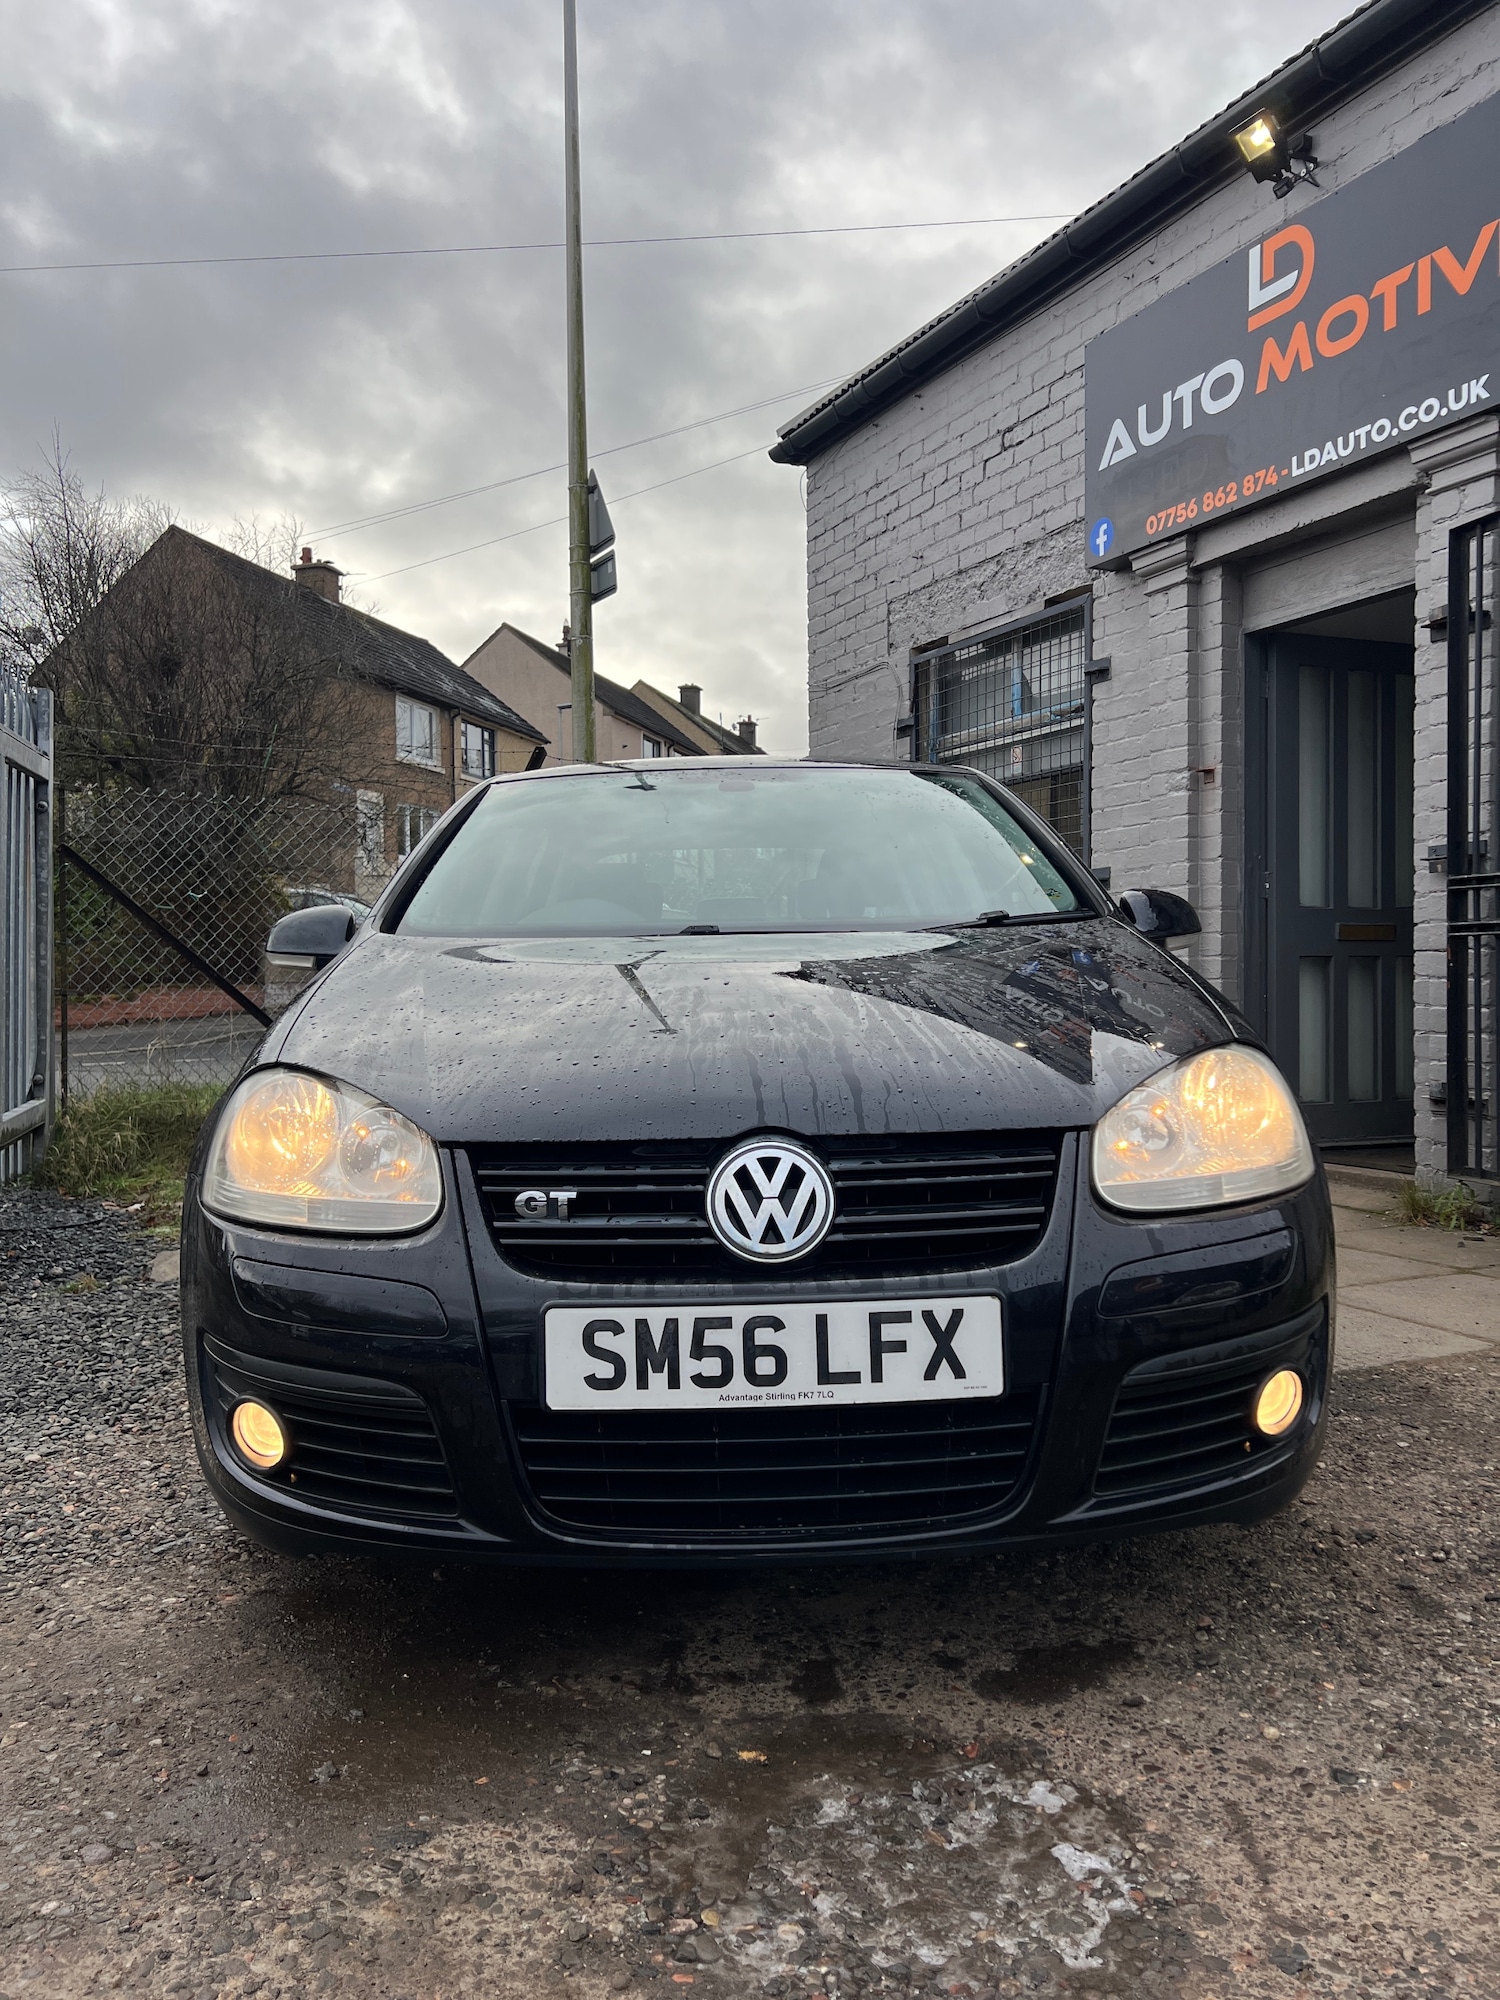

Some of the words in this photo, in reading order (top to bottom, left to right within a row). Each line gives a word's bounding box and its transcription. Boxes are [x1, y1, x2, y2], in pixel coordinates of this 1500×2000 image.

[1247, 223, 1316, 333] LD
[1098, 358, 1245, 472] AUTO
[1254, 217, 1500, 395] MOTIV
[1145, 497, 1198, 535] 07756
[1202, 481, 1238, 513] 862
[1241, 464, 1279, 497] 874
[1290, 372, 1491, 478] LDAUTO.CO.UK
[514, 1190, 578, 1224] GT
[581, 1315, 788, 1391] SM56
[815, 1308, 967, 1386] LFX
[718, 1393, 763, 1402] Advantage
[765, 1392, 796, 1401] Stirling
[798, 1391, 815, 1400] FK7
[817, 1390, 835, 1399] 7LQ
